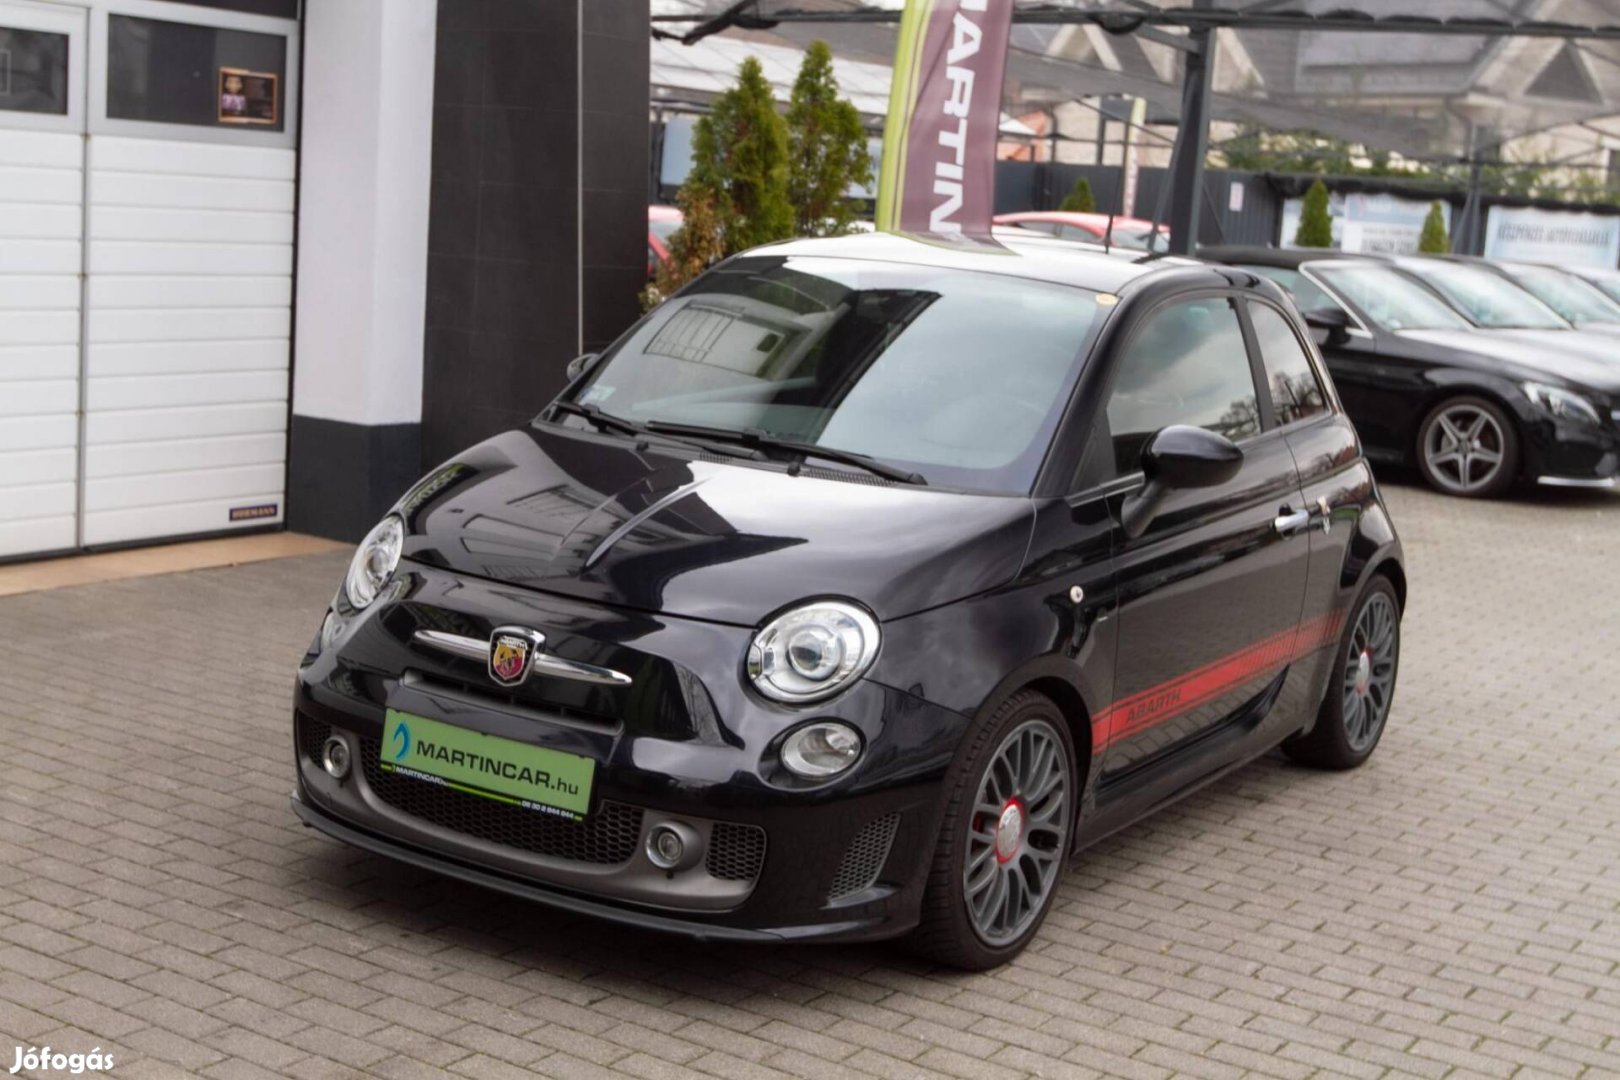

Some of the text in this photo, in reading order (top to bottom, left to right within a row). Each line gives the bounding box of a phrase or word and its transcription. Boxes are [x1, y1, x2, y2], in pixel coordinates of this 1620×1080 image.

[929, 0, 988, 234] ARTIN
[395, 766, 449, 786] MARTINCAR
[416, 740, 579, 796] MARTINCAR.hu
